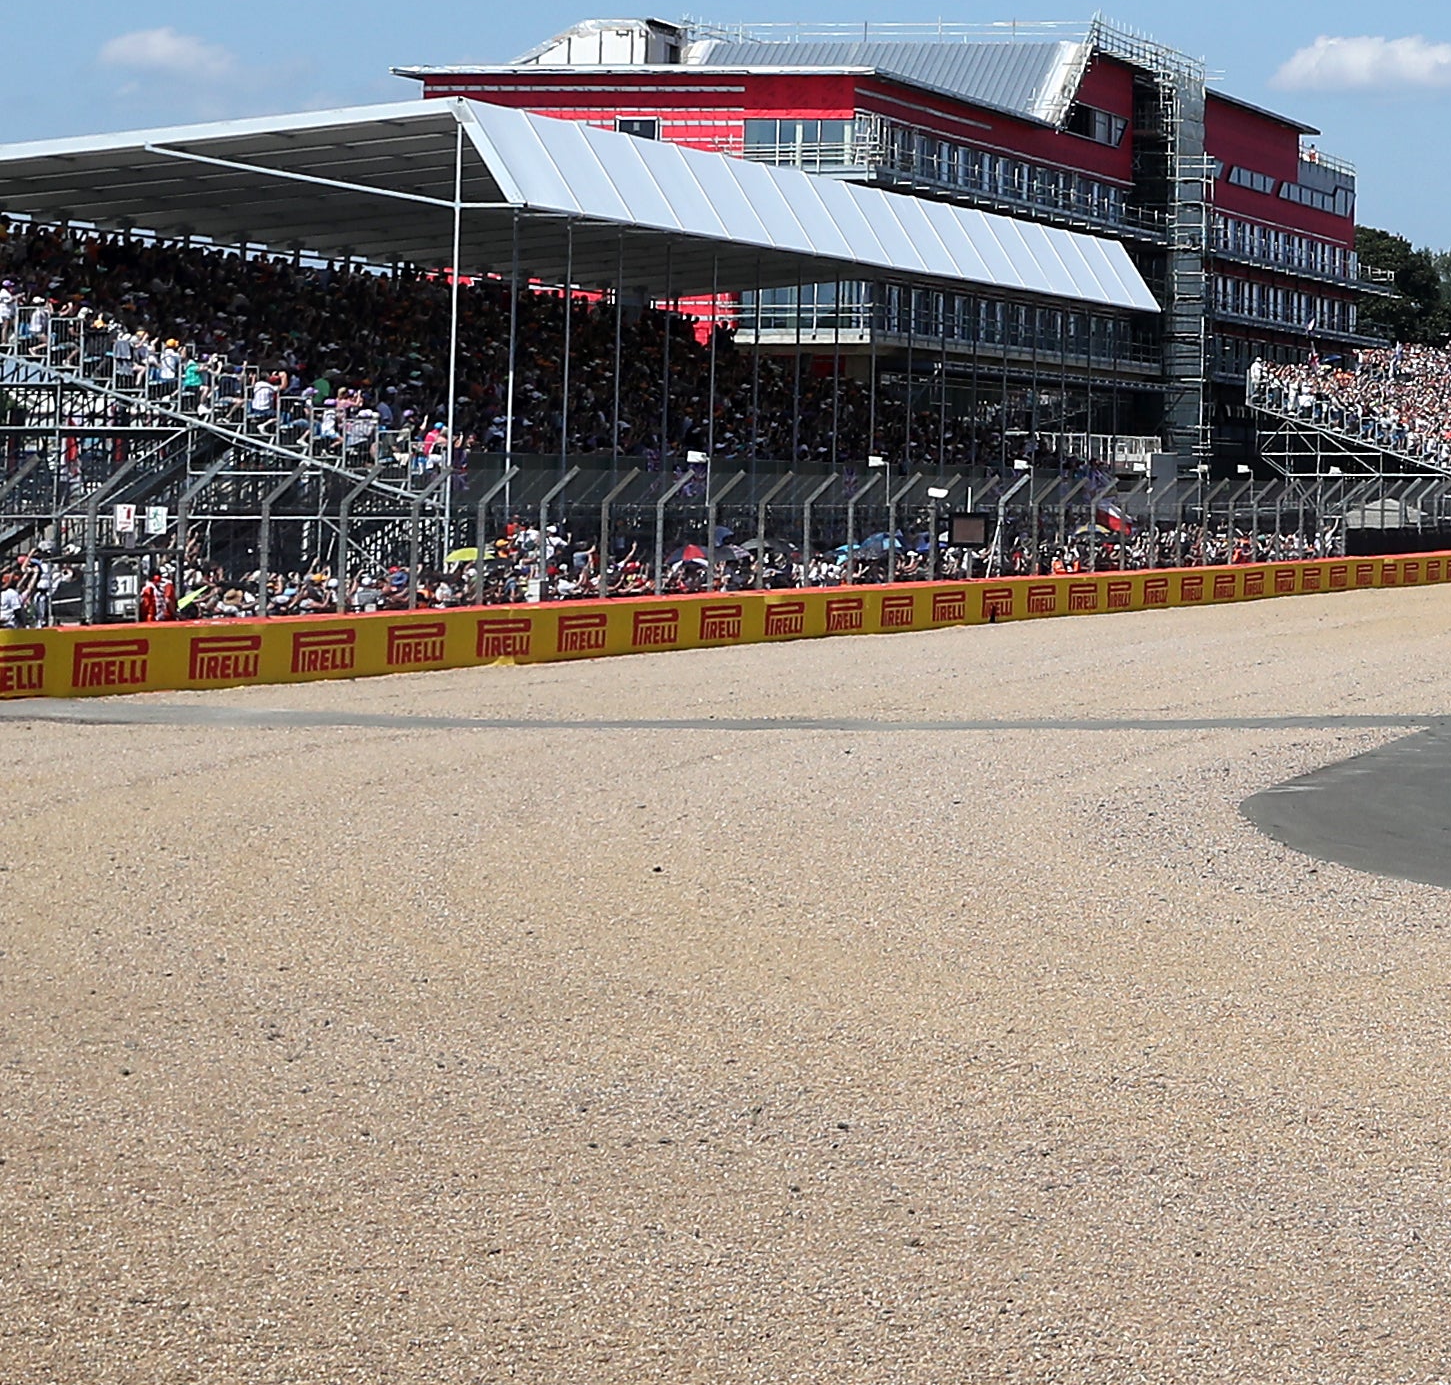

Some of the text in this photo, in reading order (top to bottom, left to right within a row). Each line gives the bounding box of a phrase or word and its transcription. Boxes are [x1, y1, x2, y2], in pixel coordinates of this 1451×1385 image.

[72, 638, 149, 687] PIRELLI
[189, 635, 261, 679] PIRELLI
[291, 628, 356, 672] PIRELLI
[387, 622, 446, 664] PIRELLI
[477, 618, 531, 657] PIRELLI
[557, 613, 607, 652] PIRELLI
[632, 608, 679, 646] PIRELLI
[700, 604, 742, 640] PIRELLI
[764, 602, 804, 636] PIRELLI
[826, 598, 863, 632] PIRELLI
[881, 595, 913, 627] PIRELLI
[932, 590, 966, 621] PIRELLI
[1027, 584, 1056, 613] PIRELLI
[1068, 583, 1097, 611] PIRELLI
